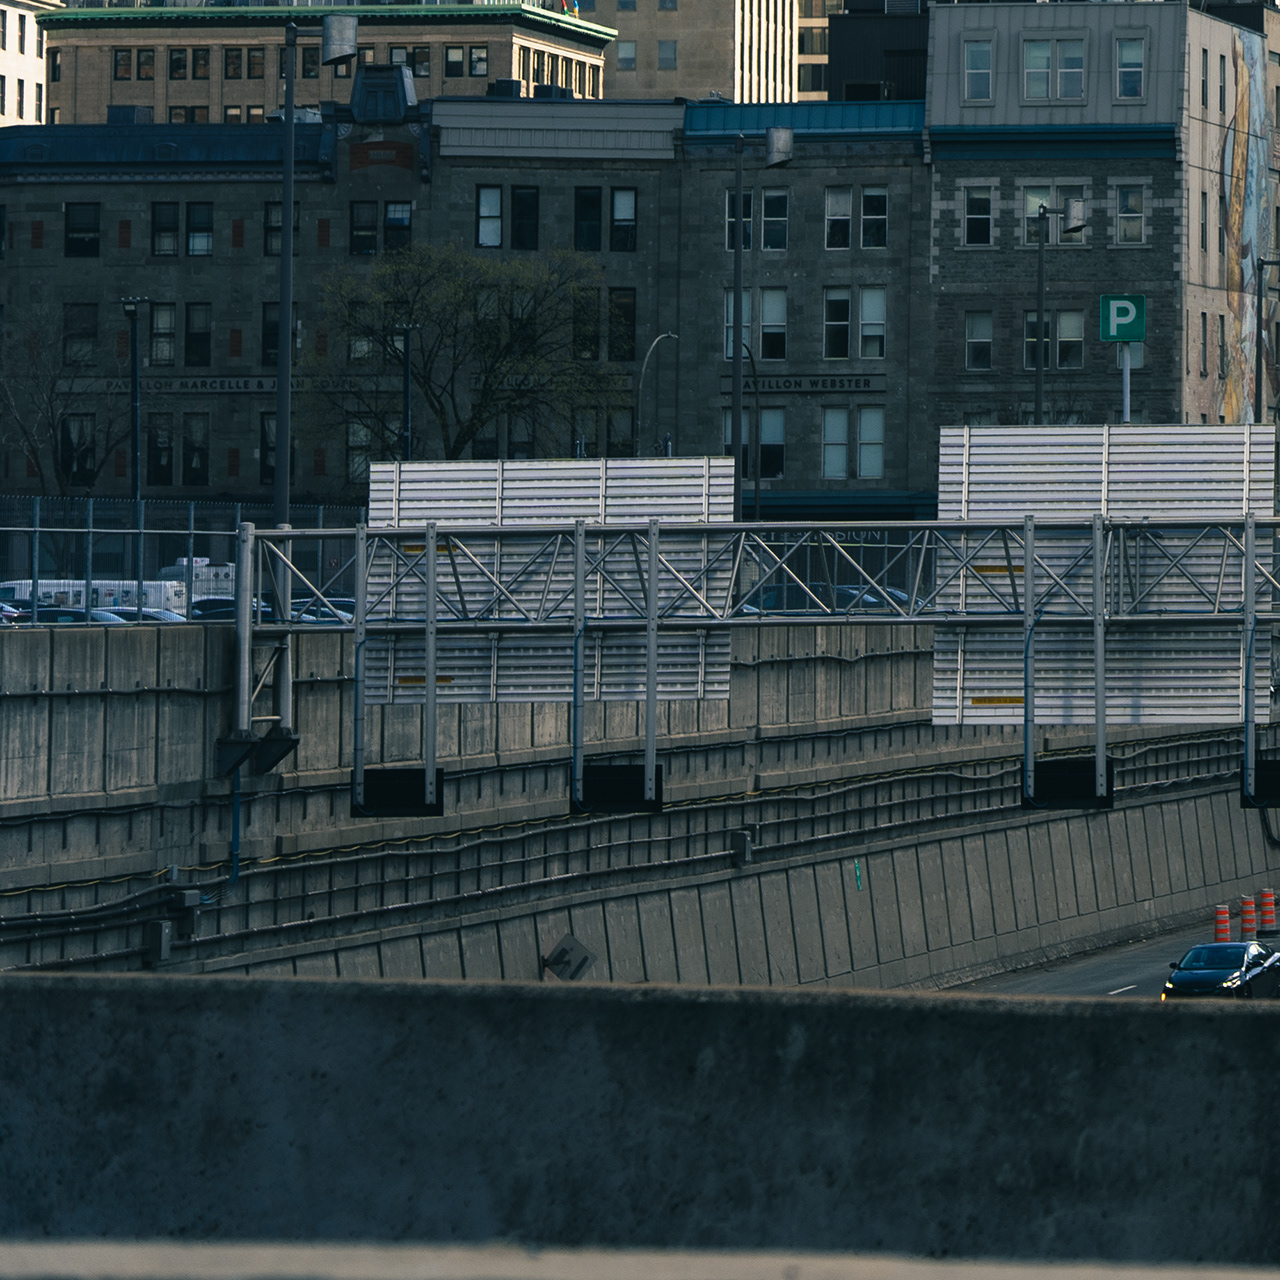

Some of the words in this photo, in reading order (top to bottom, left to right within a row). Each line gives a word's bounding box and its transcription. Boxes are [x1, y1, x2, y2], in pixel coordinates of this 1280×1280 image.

[1109, 300, 1137, 336] P
[106, 380, 173, 390] PAVLLON
[180, 379, 250, 390] MARCELLE
[809, 378, 871, 389] WEBSTER
